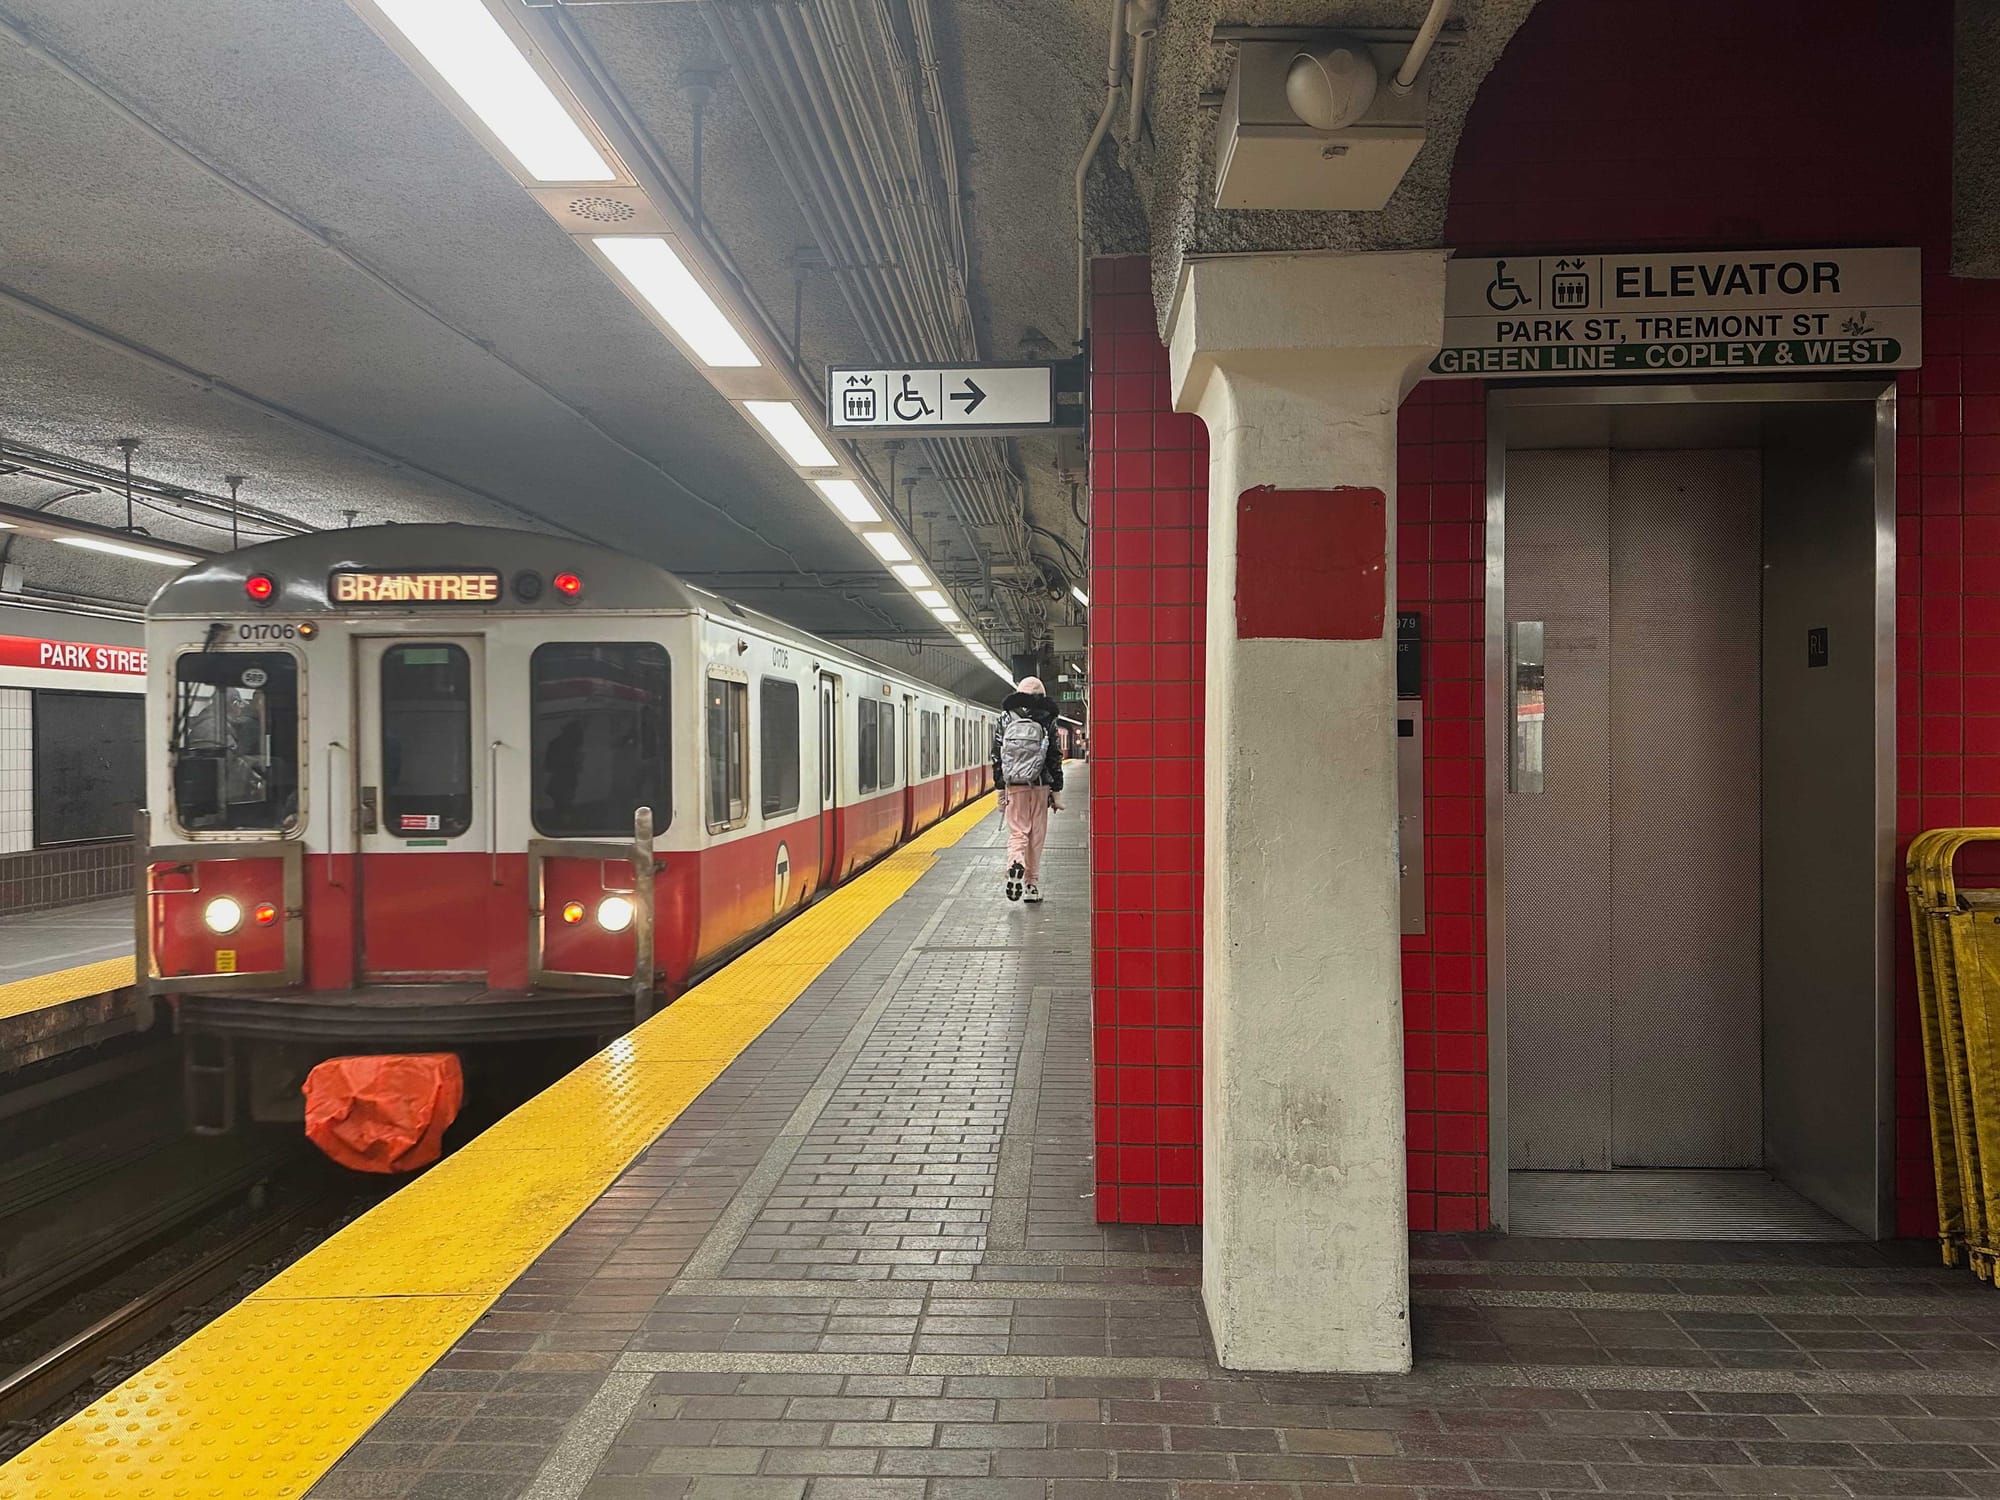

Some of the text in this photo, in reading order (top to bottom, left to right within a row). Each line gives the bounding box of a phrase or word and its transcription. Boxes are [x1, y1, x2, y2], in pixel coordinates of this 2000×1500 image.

[1616, 261, 1841, 298] ELEVATOR
[1497, 313, 1830, 345] PARK ST, TREMONT ST
[1440, 347, 1540, 373] GREEN
[1551, 345, 1616, 370] LINE
[1645, 342, 1767, 368] COPLEY
[1774, 341, 1795, 365] &
[1803, 339, 1889, 364] WEST
[337, 574, 498, 601] BRAINTREE
[240, 623, 296, 640] 01706
[1810, 634, 1825, 656] RL
[40, 642, 148, 673] PARK STREE
